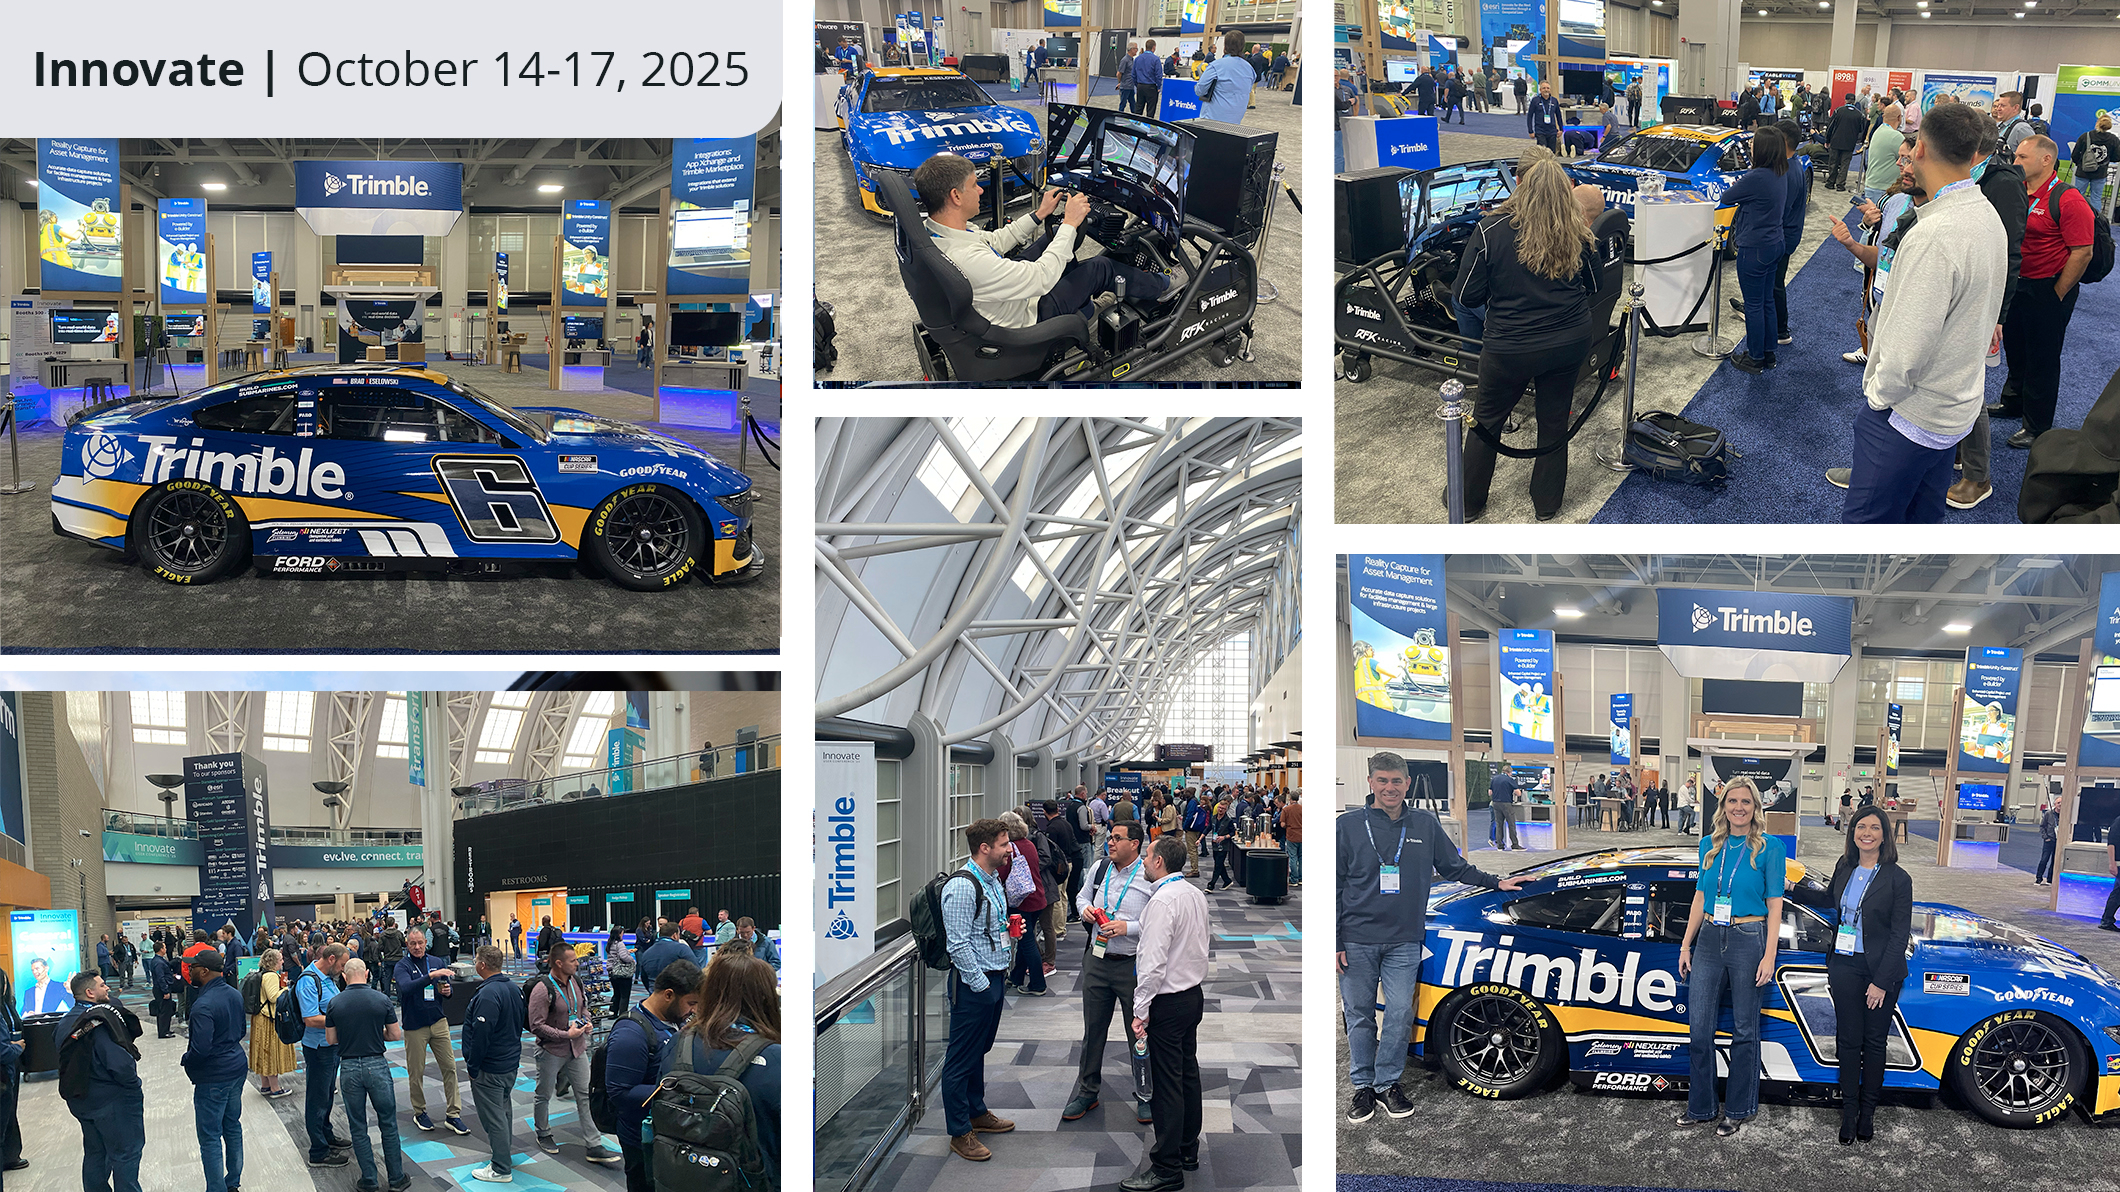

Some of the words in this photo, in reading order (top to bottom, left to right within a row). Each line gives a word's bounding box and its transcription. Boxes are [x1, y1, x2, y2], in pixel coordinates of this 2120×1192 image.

[1175, 100, 1197, 110] Trimble
[873, 119, 1034, 145] Trimble
[52, 140, 72, 151] Reality
[73, 144, 97, 153] Capture
[1398, 143, 1429, 154] Trimble
[49, 148, 67, 157] Asset
[69, 151, 109, 163] Management
[727, 155, 741, 163] and
[682, 168, 704, 176] Trimble
[706, 164, 744, 173] Marketplace
[346, 174, 430, 197] Trimble
[1209, 289, 1238, 307] Trimble
[1354, 305, 1382, 320] Trimble
[1180, 319, 1206, 342] RFK
[1354, 328, 1378, 343] RFK
[238, 383, 298, 397] SUBMARINES.COM
[275, 556, 325, 567] FORD
[1365, 556, 1389, 570] Reality
[1390, 561, 1419, 574] Capture
[1420, 566, 1431, 575] for
[154, 566, 192, 583] EAGLE
[663, 556, 696, 587] EAGLE
[1363, 566, 1384, 577] Asset
[1386, 571, 1433, 586] Management
[1361, 586, 1383, 594] Accurate
[1396, 592, 1414, 600] capture
[1415, 594, 1436, 604] solutions
[1718, 606, 1813, 637] Trimble
[823, 752, 861, 760] Innovate
[194, 761, 218, 770] Thank
[219, 761, 234, 769] you
[211, 769, 236, 777] sponsors
[252, 777, 268, 875] Trimble
[134, 841, 176, 854] Innovate
[828, 796, 856, 909] Trimble
[323, 851, 359, 862] evolve,
[361, 851, 404, 862] connect,
[501, 875, 548, 886] RESTROOMS
[1557, 875, 1627, 888] SUBMARINES.COM
[1594, 1072, 1651, 1085] FORD
[1457, 1077, 1500, 1098] EAGLE
[1592, 1084, 1648, 1092] PERFORMANCE
[2035, 1093, 2074, 1124] EAGLE
